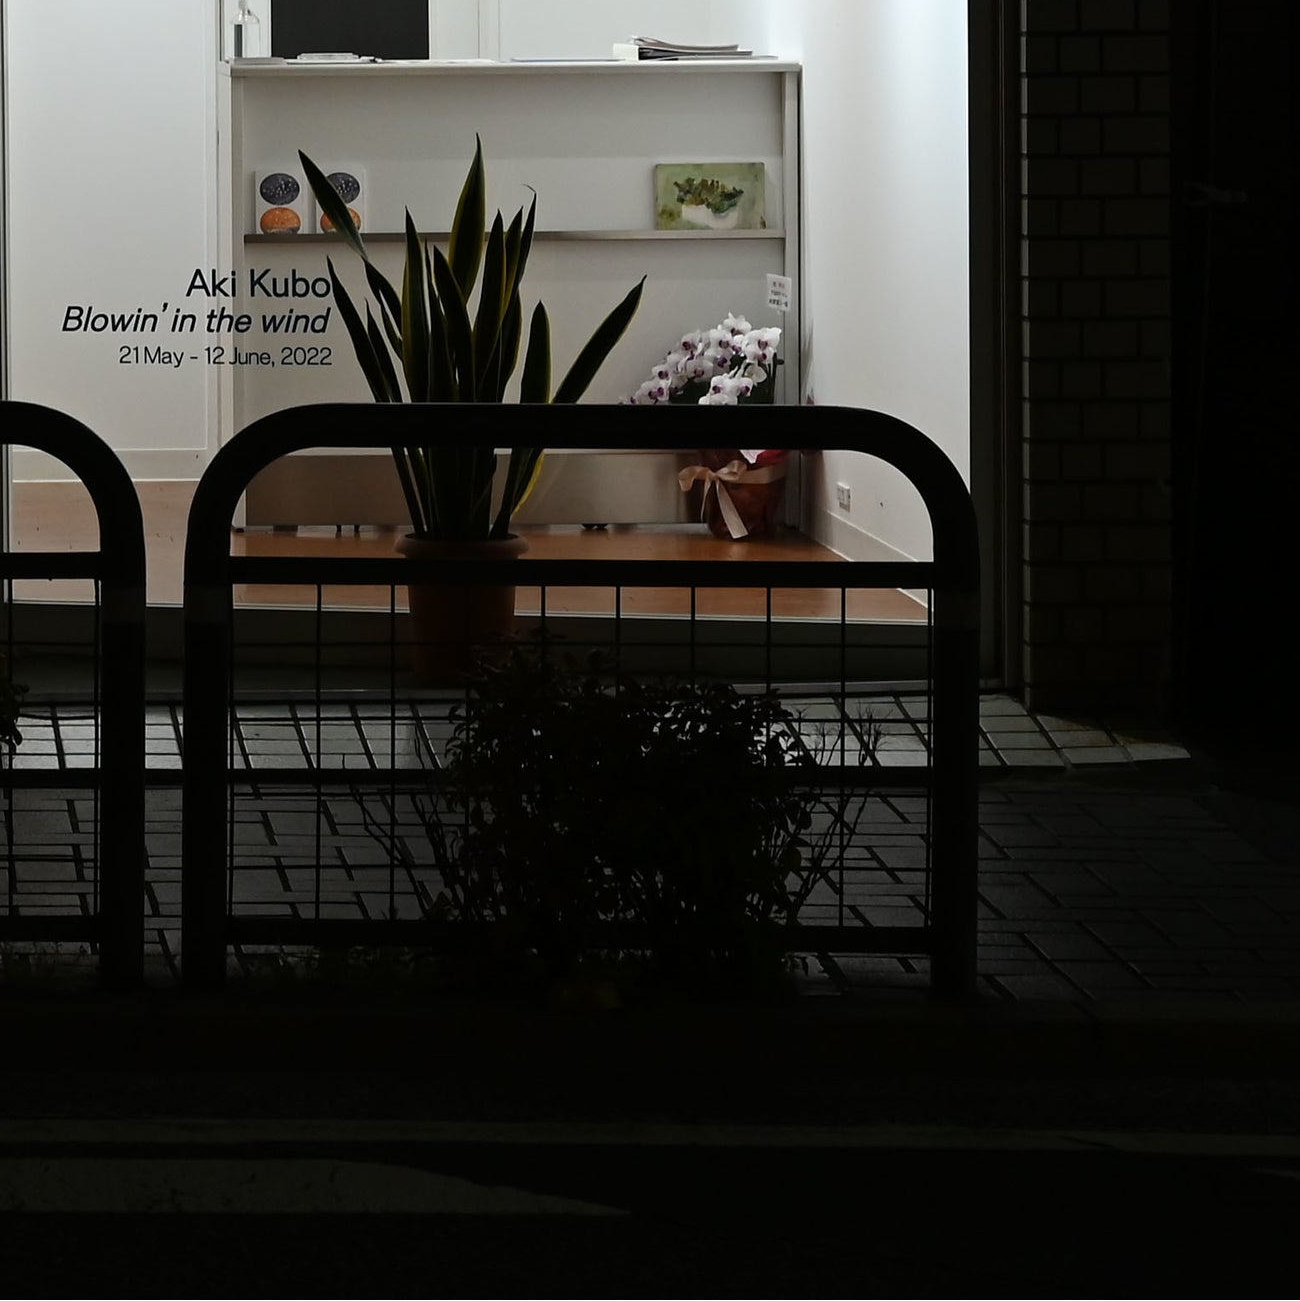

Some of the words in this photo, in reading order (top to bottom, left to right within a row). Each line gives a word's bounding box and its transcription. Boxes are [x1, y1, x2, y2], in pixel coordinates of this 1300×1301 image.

[185, 268, 237, 298] Aki
[249, 268, 331, 299] Kubo
[171, 308, 197, 333] in
[206, 306, 253, 334] the
[261, 306, 332, 334] wind
[119, 345, 140, 364] 21
[143, 345, 185, 369] May
[204, 346, 225, 365] 12
[228, 346, 276, 368] June,
[280, 346, 333, 366] 2022
